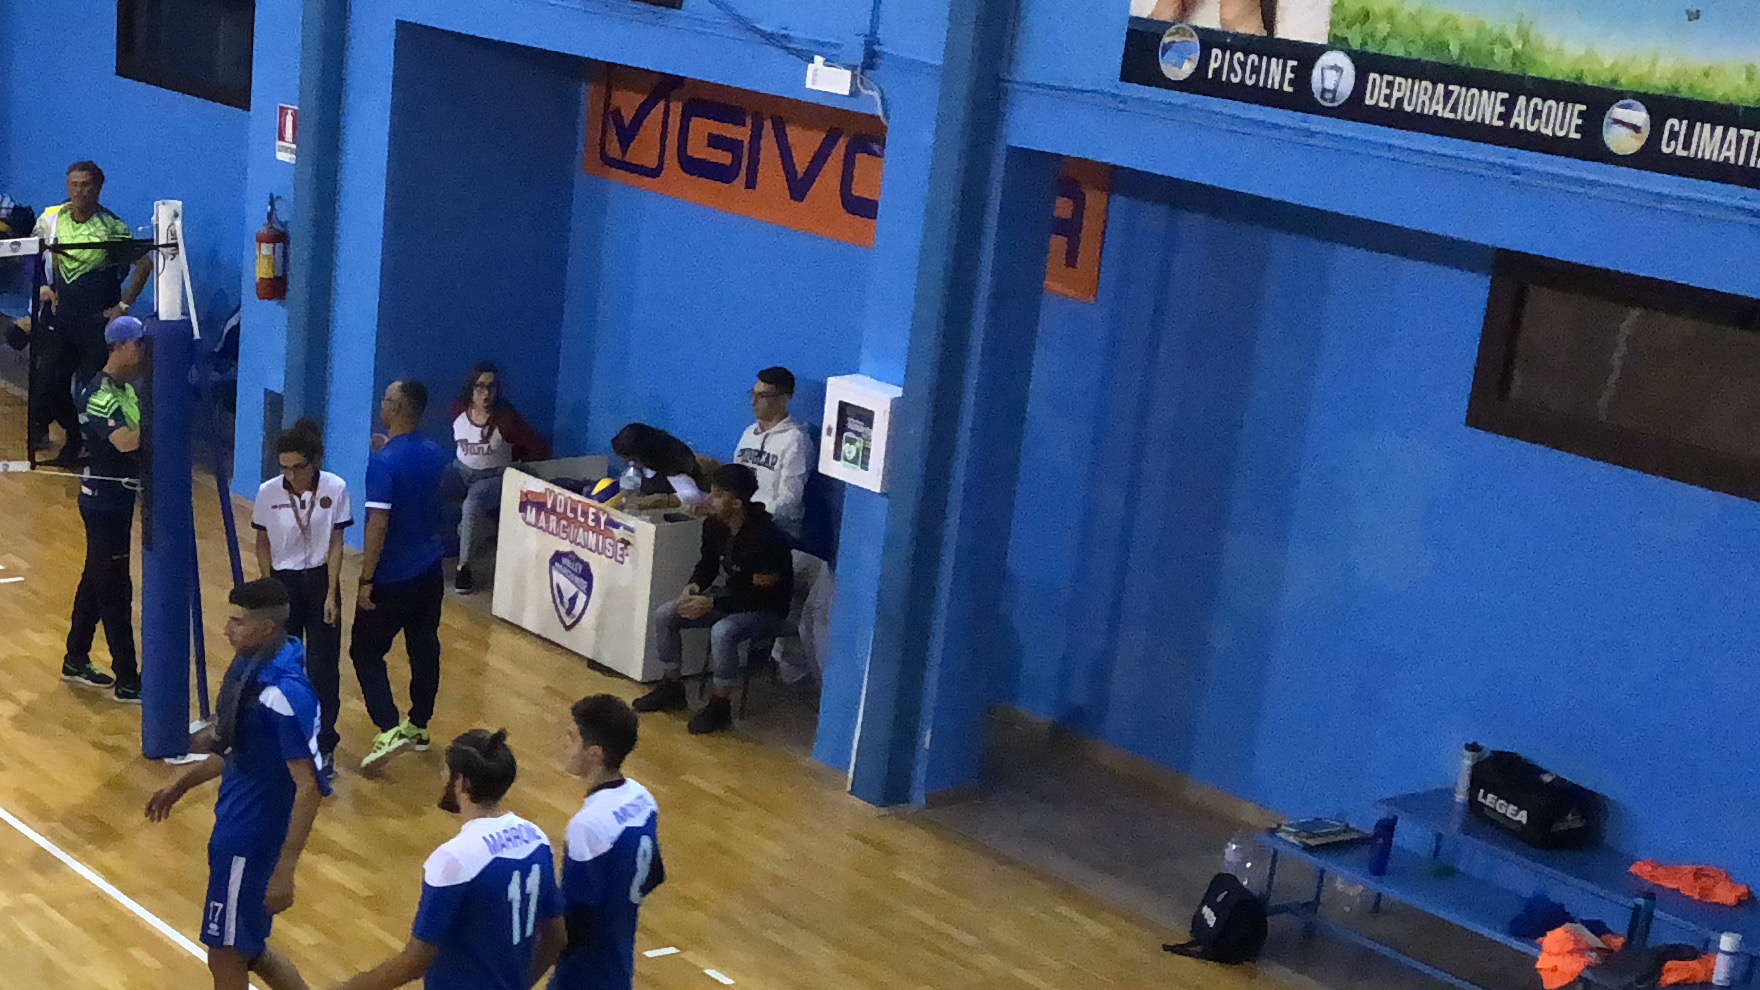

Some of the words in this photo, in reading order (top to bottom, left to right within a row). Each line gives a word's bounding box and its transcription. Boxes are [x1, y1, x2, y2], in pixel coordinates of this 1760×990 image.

[1206, 48, 1298, 93] PISCINE
[1365, 73, 1508, 127] DEPURAZIONE
[1508, 94, 1587, 140] ACQUE
[1660, 117, 1760, 169] CLIMATI
[545, 488, 609, 531] VOLLEY
[525, 504, 626, 566] MARCIANISE
[1477, 788, 1528, 825] LEGEA
[207, 900, 224, 924] 17
[507, 863, 541, 946] 11
